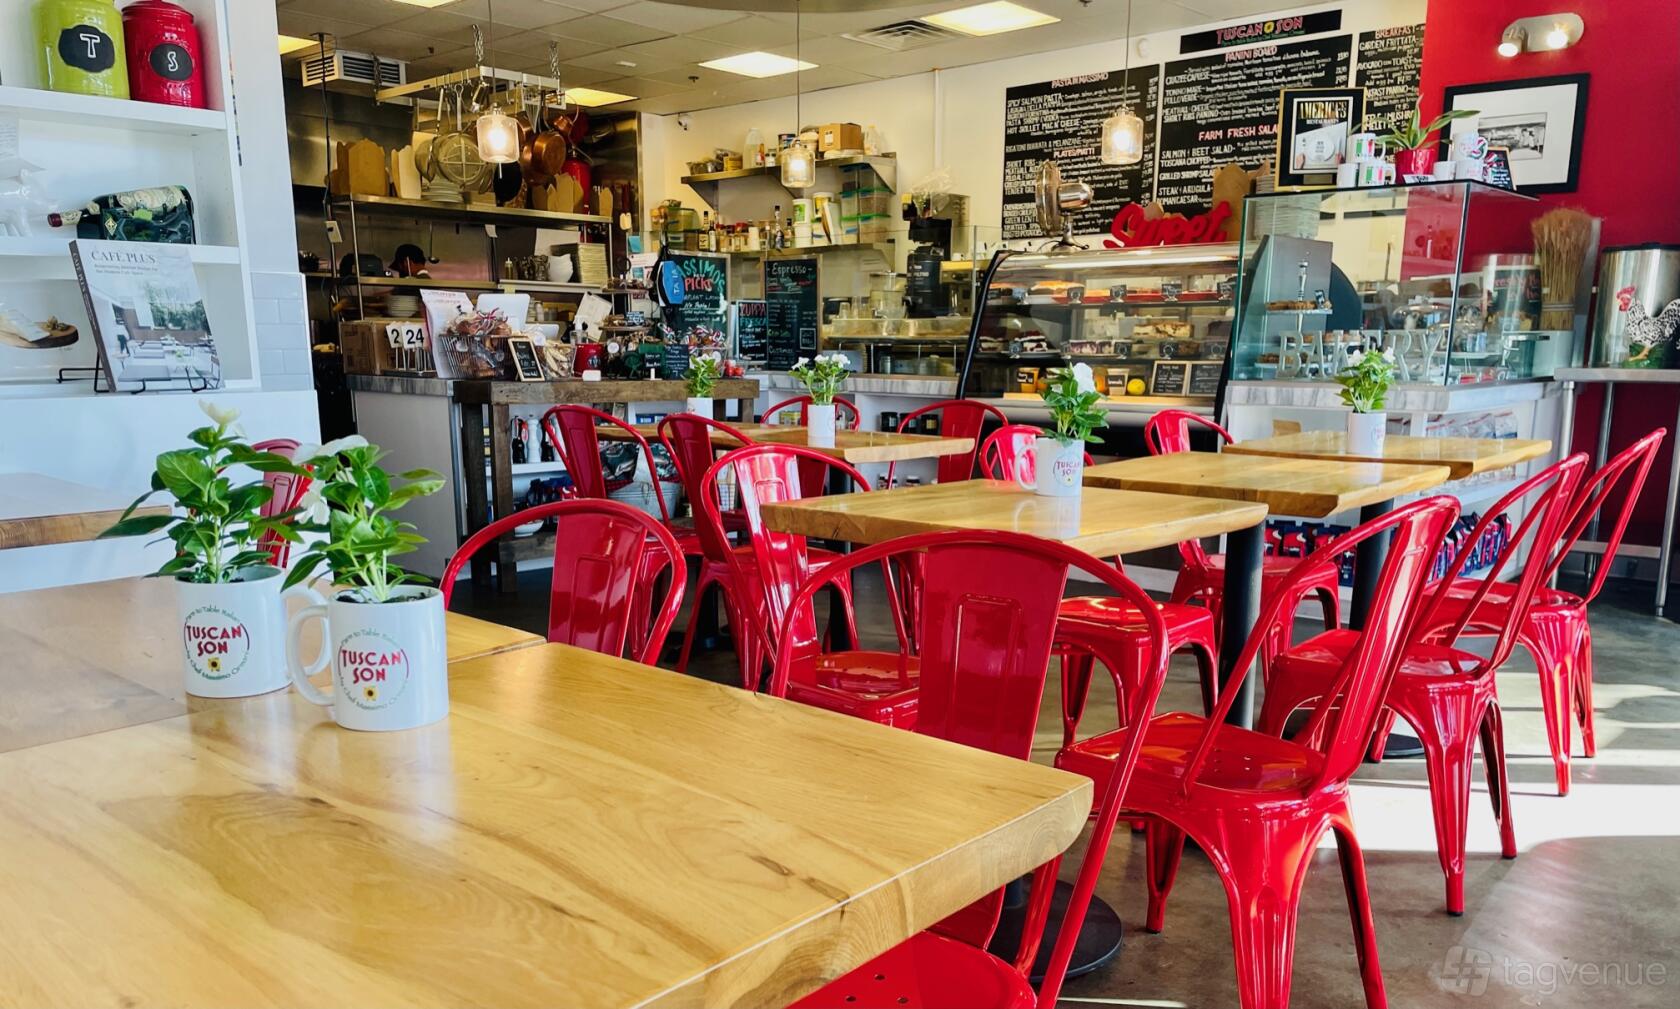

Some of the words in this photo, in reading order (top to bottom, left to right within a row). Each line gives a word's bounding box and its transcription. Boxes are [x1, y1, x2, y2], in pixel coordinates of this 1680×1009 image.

[1216, 23, 1263, 45] TUSCAN
[1275, 16, 1303, 34] SON
[1375, 26, 1415, 39] BREAKFAST
[80, 33, 100, 58] T
[1359, 39, 1385, 51] GARDEN
[167, 51, 178, 72] S
[1051, 77, 1072, 89] PASTA
[1006, 126, 1018, 135] HOT
[1199, 130, 1223, 141] FARM
[1227, 126, 1256, 138] FRESH
[1257, 123, 1279, 135] SALA
[1161, 149, 1186, 159] SALMON
[1191, 146, 1210, 157] BEET
[1160, 158, 1186, 168] TOSCANA
[1159, 171, 1180, 181] GRILLED
[1158, 186, 1179, 196] STEAK
[1103, 200, 1233, 249] Sweet
[126, 252, 156, 264] PLUS
[677, 257, 726, 294] SSIMO'S
[772, 262, 807, 277] Espresso
[684, 277, 712, 292] PICKS
[391, 328, 400, 344] 2
[406, 327, 425, 345] 24
[186, 624, 242, 642] TUSCAN
[197, 640, 228, 657] SON
[342, 649, 402, 668] TUSCAN
[352, 667, 386, 685] SON
